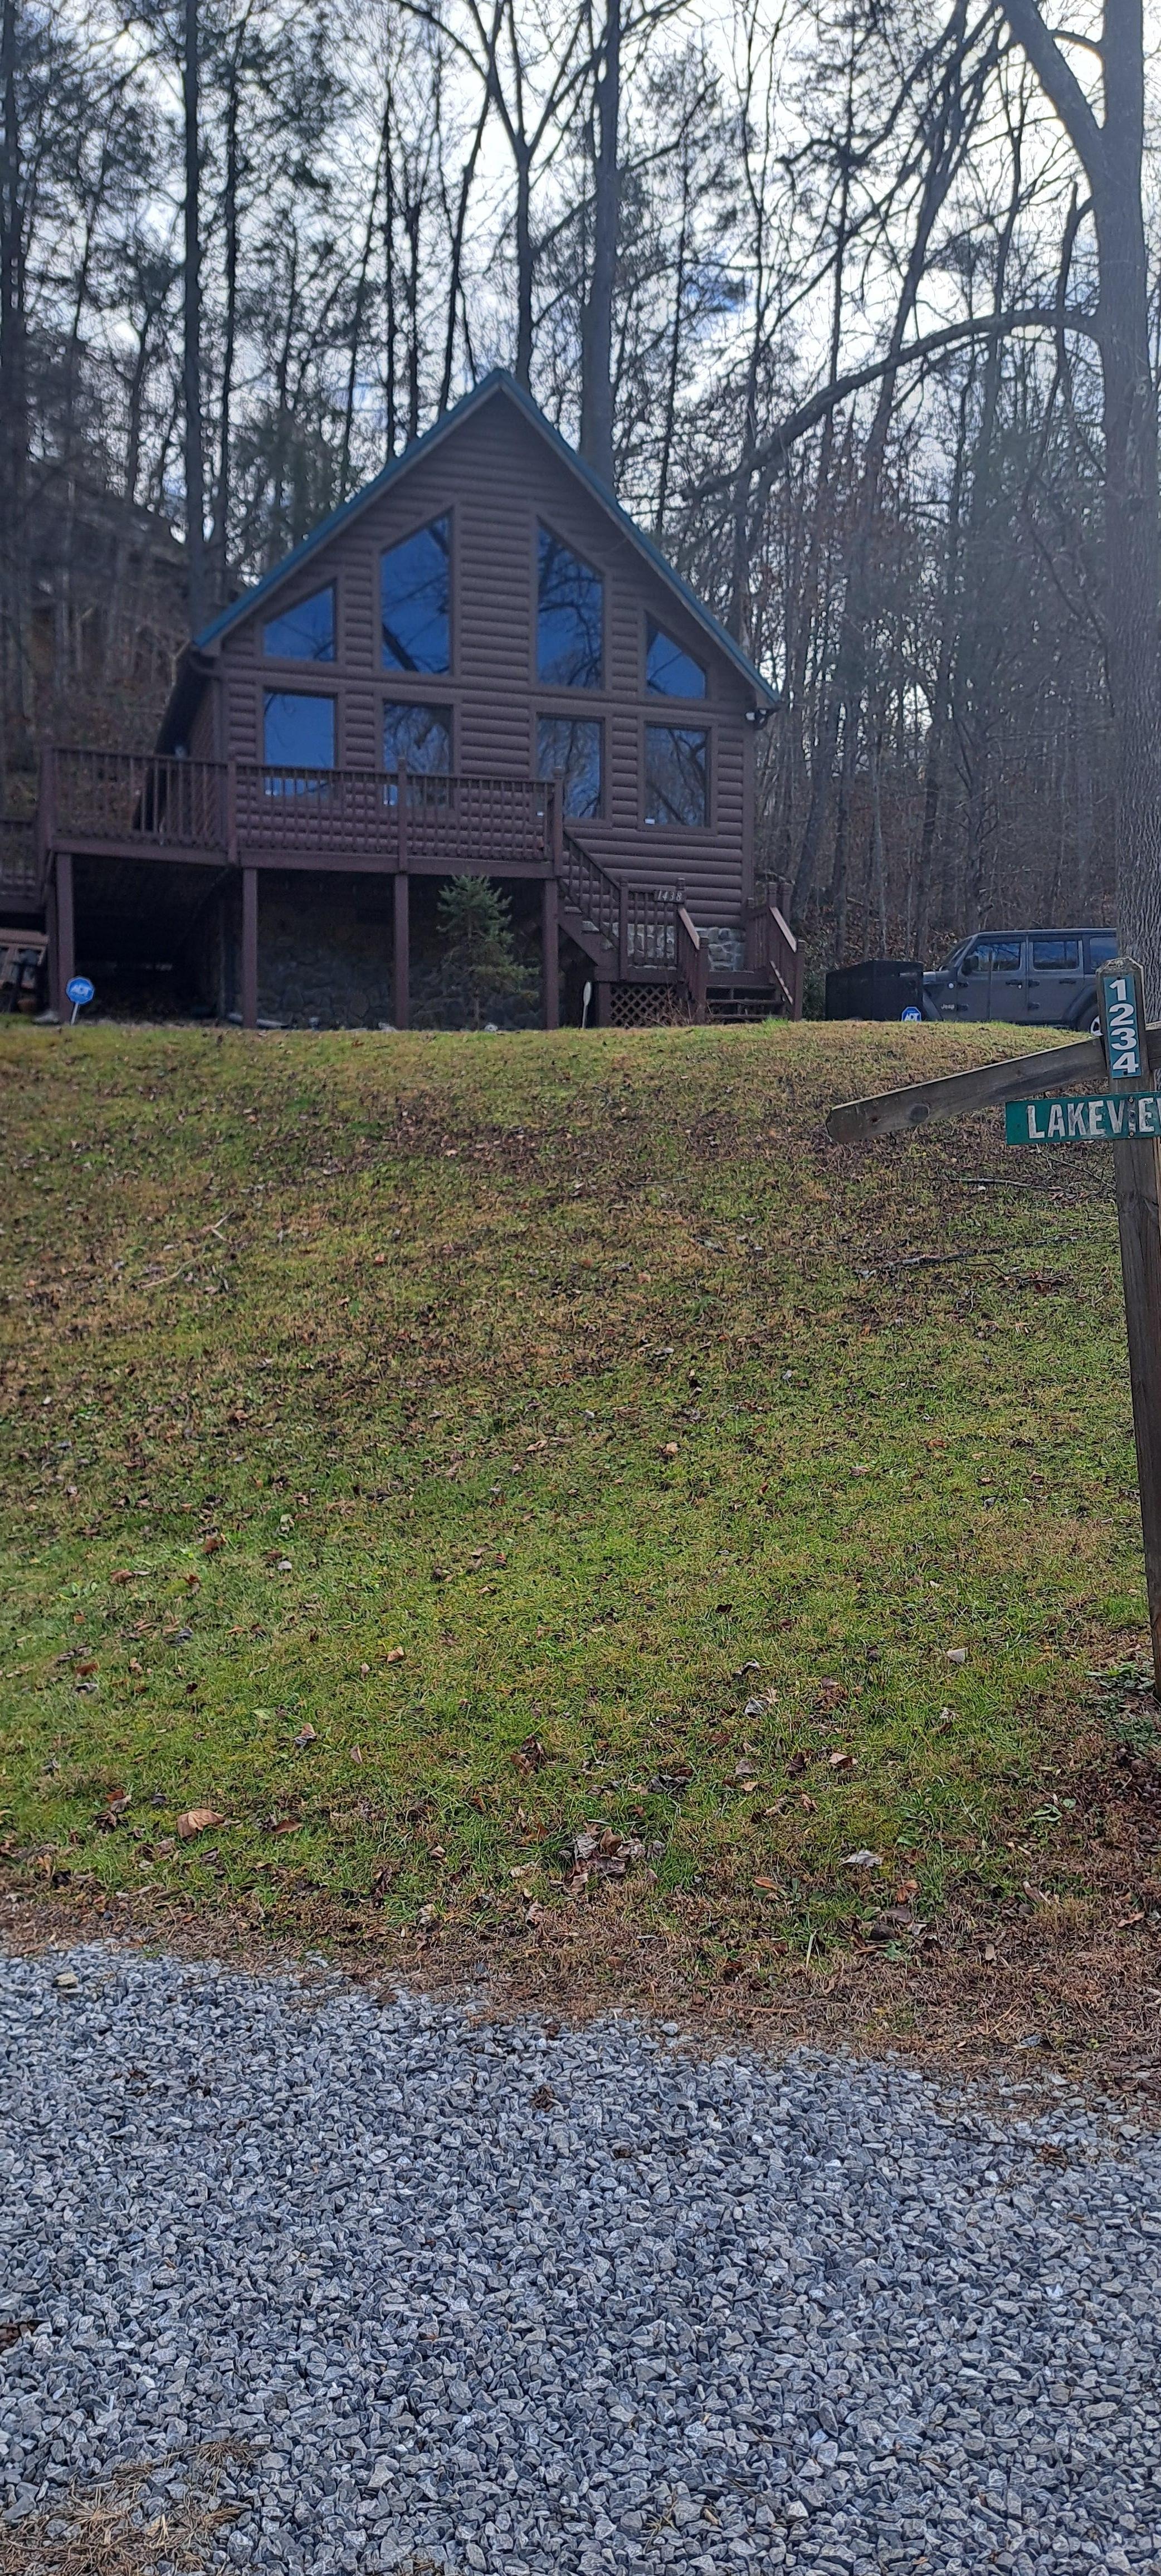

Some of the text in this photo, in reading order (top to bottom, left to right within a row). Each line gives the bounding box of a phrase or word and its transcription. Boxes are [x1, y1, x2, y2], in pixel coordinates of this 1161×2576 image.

[657, 891, 682, 901] 1438
[1109, 979, 1139, 1074] 1234
[1027, 1096, 1161, 1139] LAKEVIE
